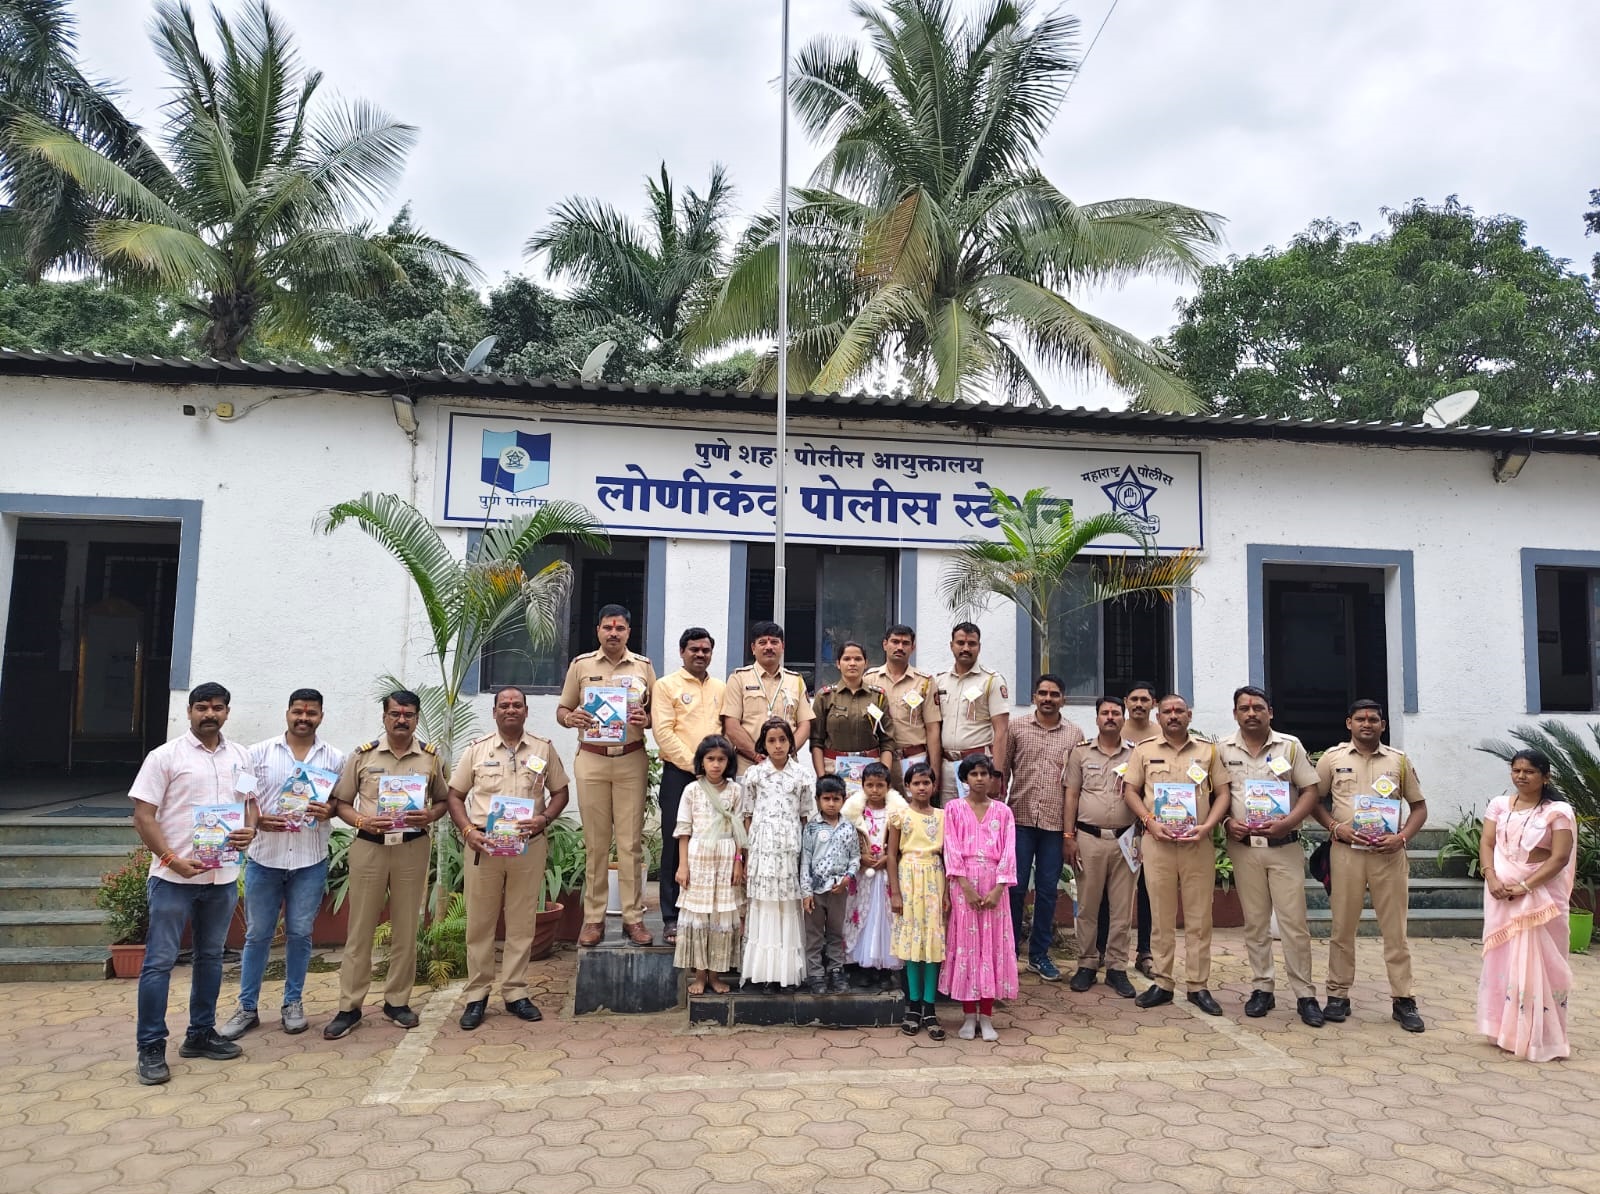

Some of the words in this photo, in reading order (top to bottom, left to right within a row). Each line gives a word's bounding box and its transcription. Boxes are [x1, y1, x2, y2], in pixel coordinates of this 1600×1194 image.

[695, 437, 731, 468] पुणे
[739, 445, 788, 468] शह
[795, 443, 864, 469] पोलीस
[872, 451, 984, 479] आयुक्तालय
[1137, 465, 1174, 486] पोलीस
[479, 493, 501, 509] पुणे
[505, 493, 549, 508] पोलीस
[800, 474, 941, 526] पोलीस
